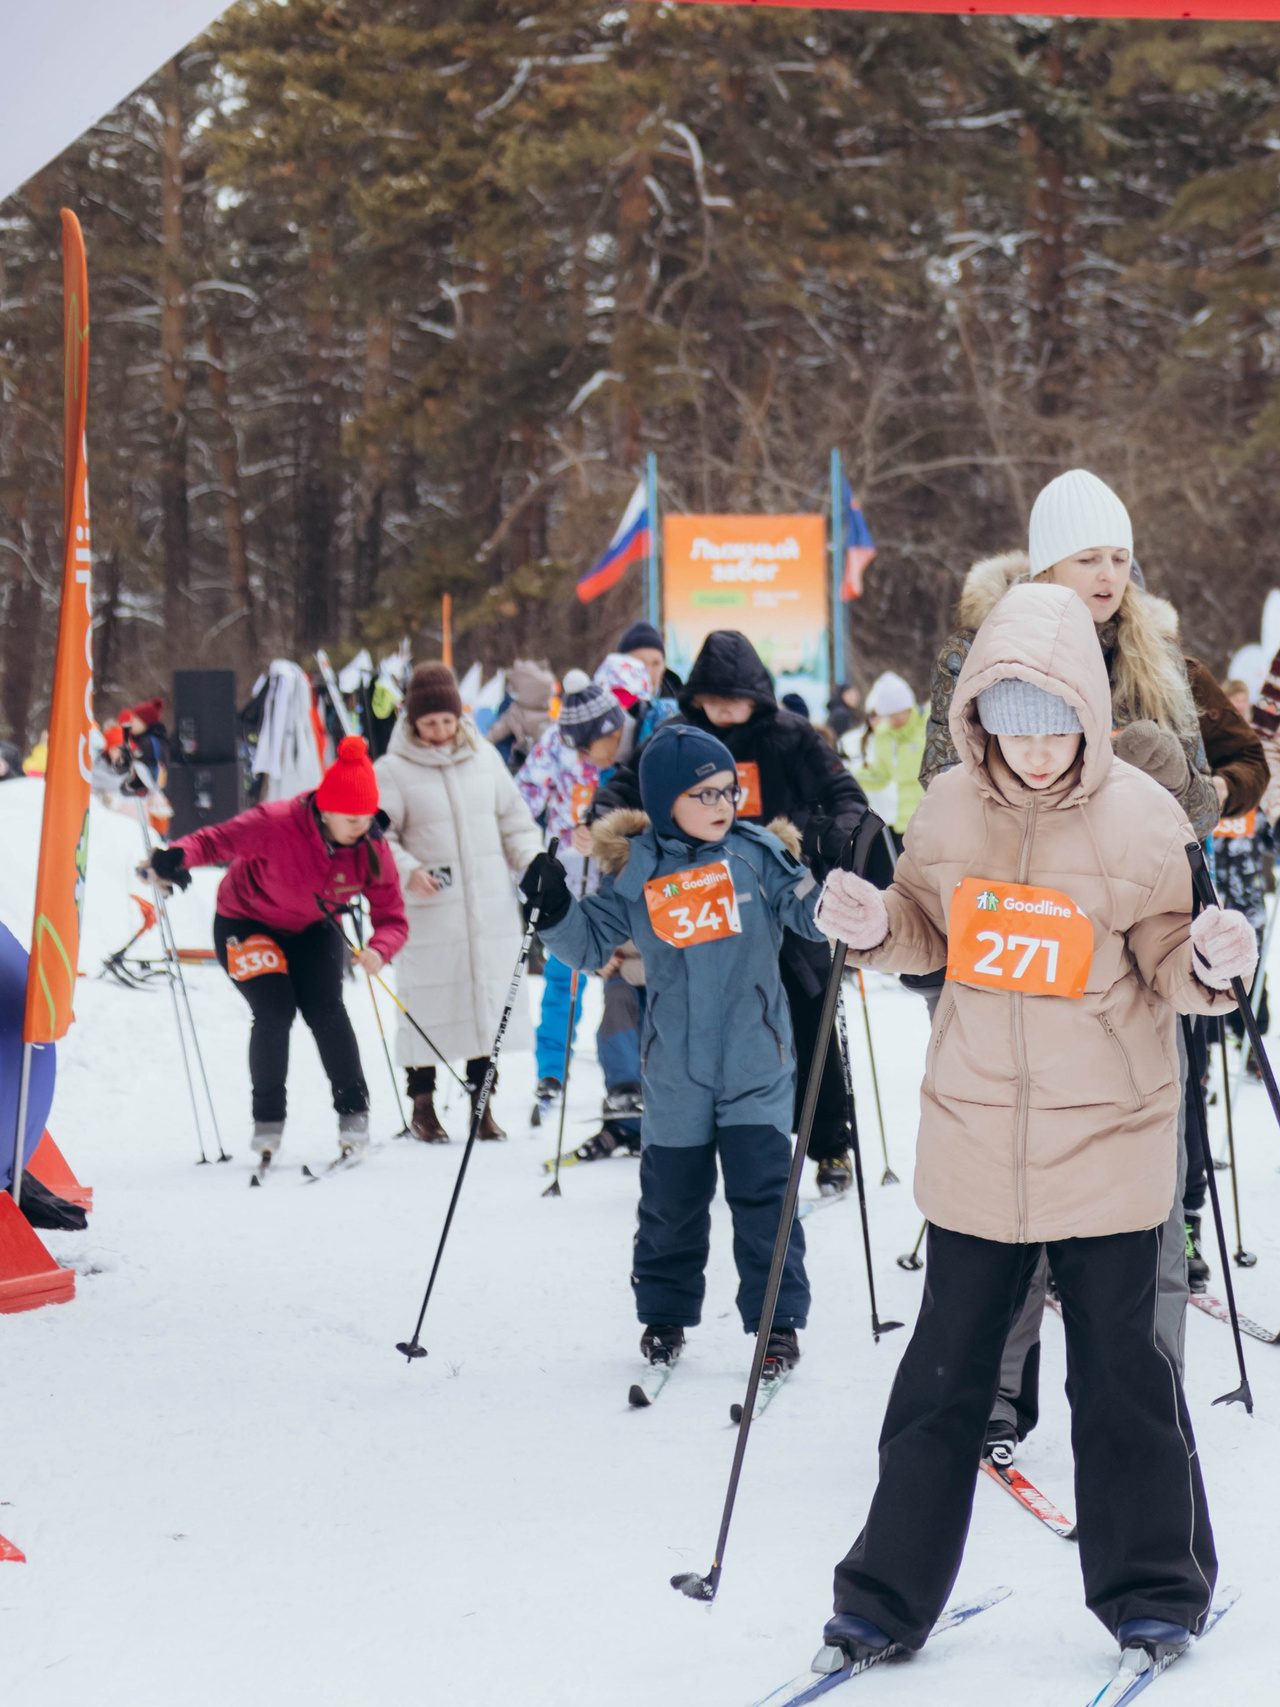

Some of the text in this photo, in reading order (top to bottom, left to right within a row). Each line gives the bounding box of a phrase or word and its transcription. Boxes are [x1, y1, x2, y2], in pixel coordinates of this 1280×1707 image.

[689, 536, 801, 560] Лыжный
[711, 558, 779, 583] забег
[681, 872, 728, 892] Goodline
[668, 896, 733, 940] 341
[1003, 897, 1072, 919] Goodline
[235, 950, 279, 977] 330
[973, 930, 1060, 983] 271
